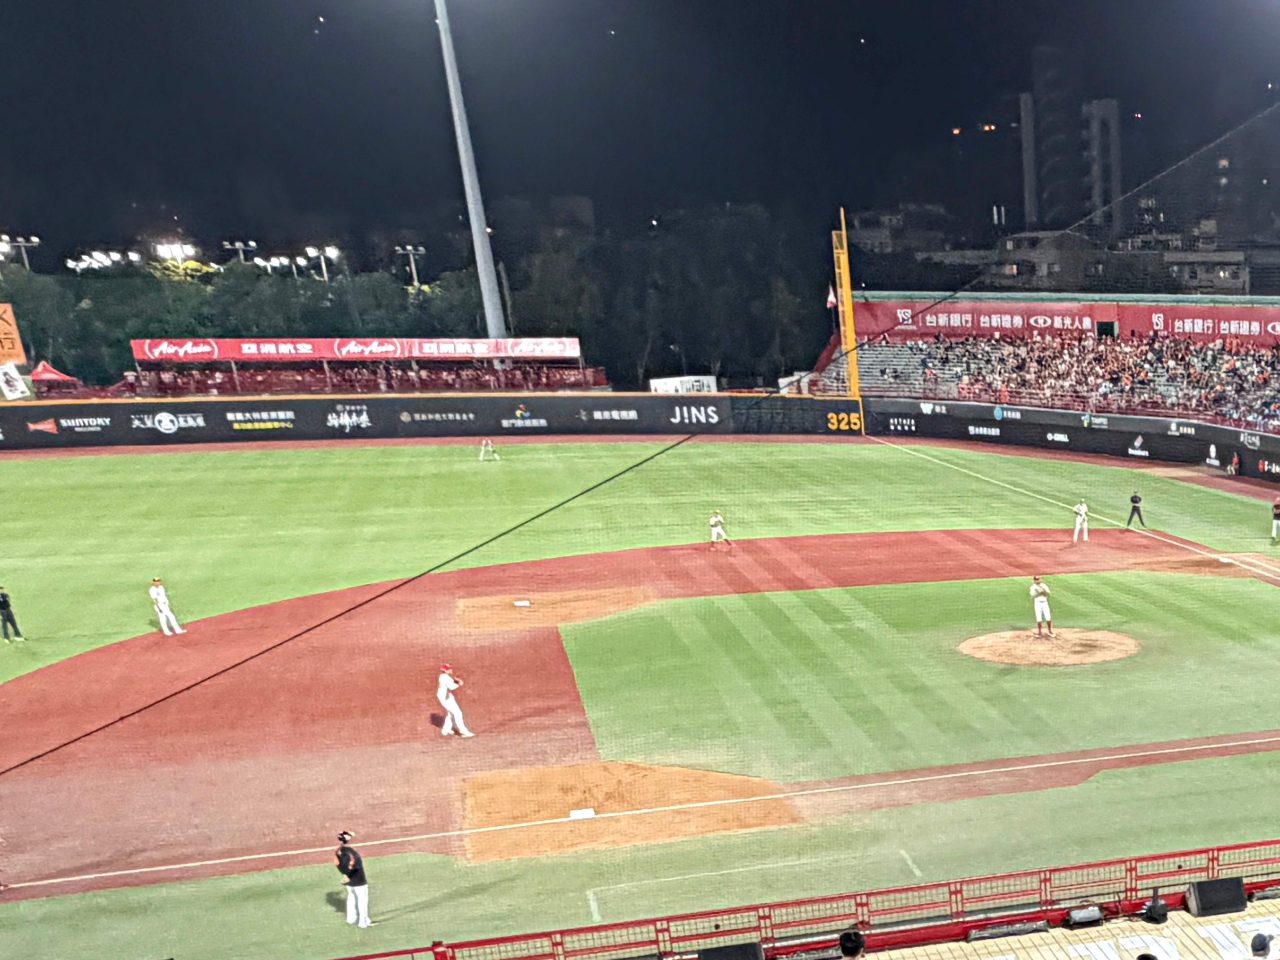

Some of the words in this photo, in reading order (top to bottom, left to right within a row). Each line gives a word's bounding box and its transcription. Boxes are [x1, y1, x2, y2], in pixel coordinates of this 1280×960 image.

[925, 313, 973, 328] 台新銀行
[1174, 319, 1213, 333] 台新銀行
[153, 341, 213, 357] AirAsia
[341, 341, 396, 355] AirAsia
[60, 417, 111, 428] SUNTORY
[670, 406, 719, 424] JINS
[827, 412, 861, 431] 325
